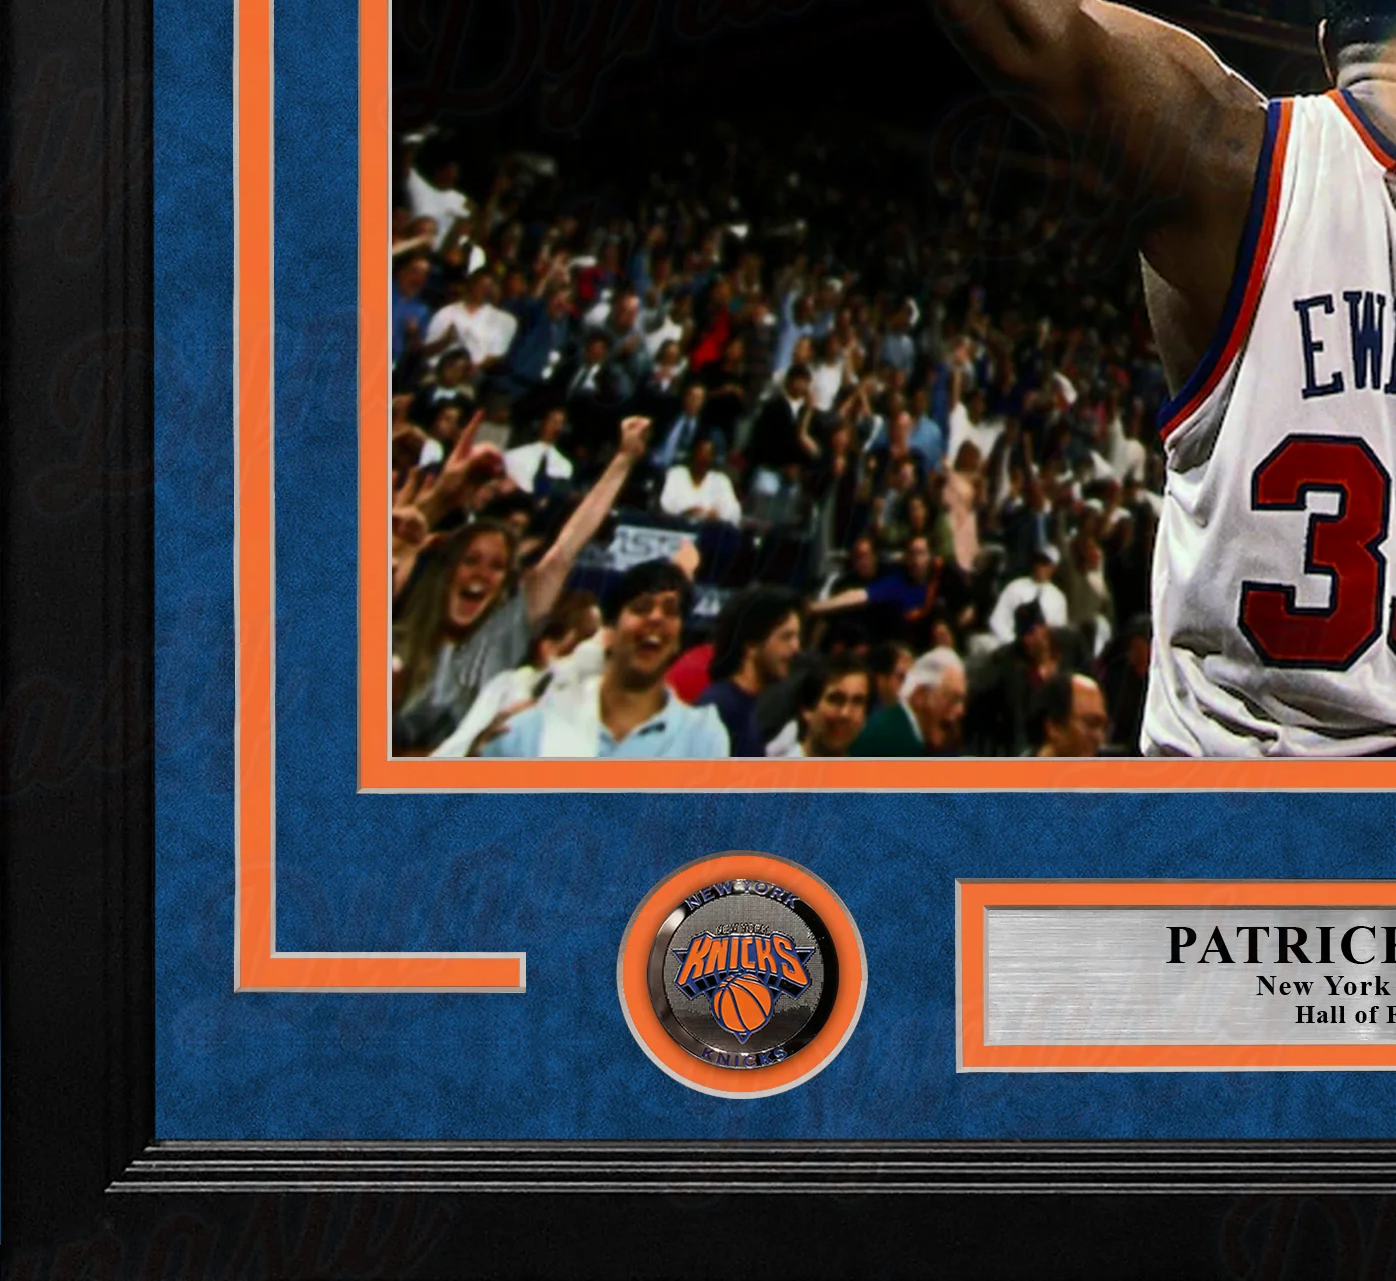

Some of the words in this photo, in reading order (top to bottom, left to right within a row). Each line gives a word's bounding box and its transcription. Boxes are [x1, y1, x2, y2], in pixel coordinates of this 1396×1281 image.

[686, 880, 734, 910] NEW
[743, 879, 797, 908] YORK
[677, 933, 810, 987] KNICKS
[1256, 975, 1314, 996] New
[1323, 975, 1391, 996] York
[1295, 1005, 1346, 1024] Hall
[1355, 1005, 1380, 1024] of
[701, 1046, 788, 1068] KNICKS
